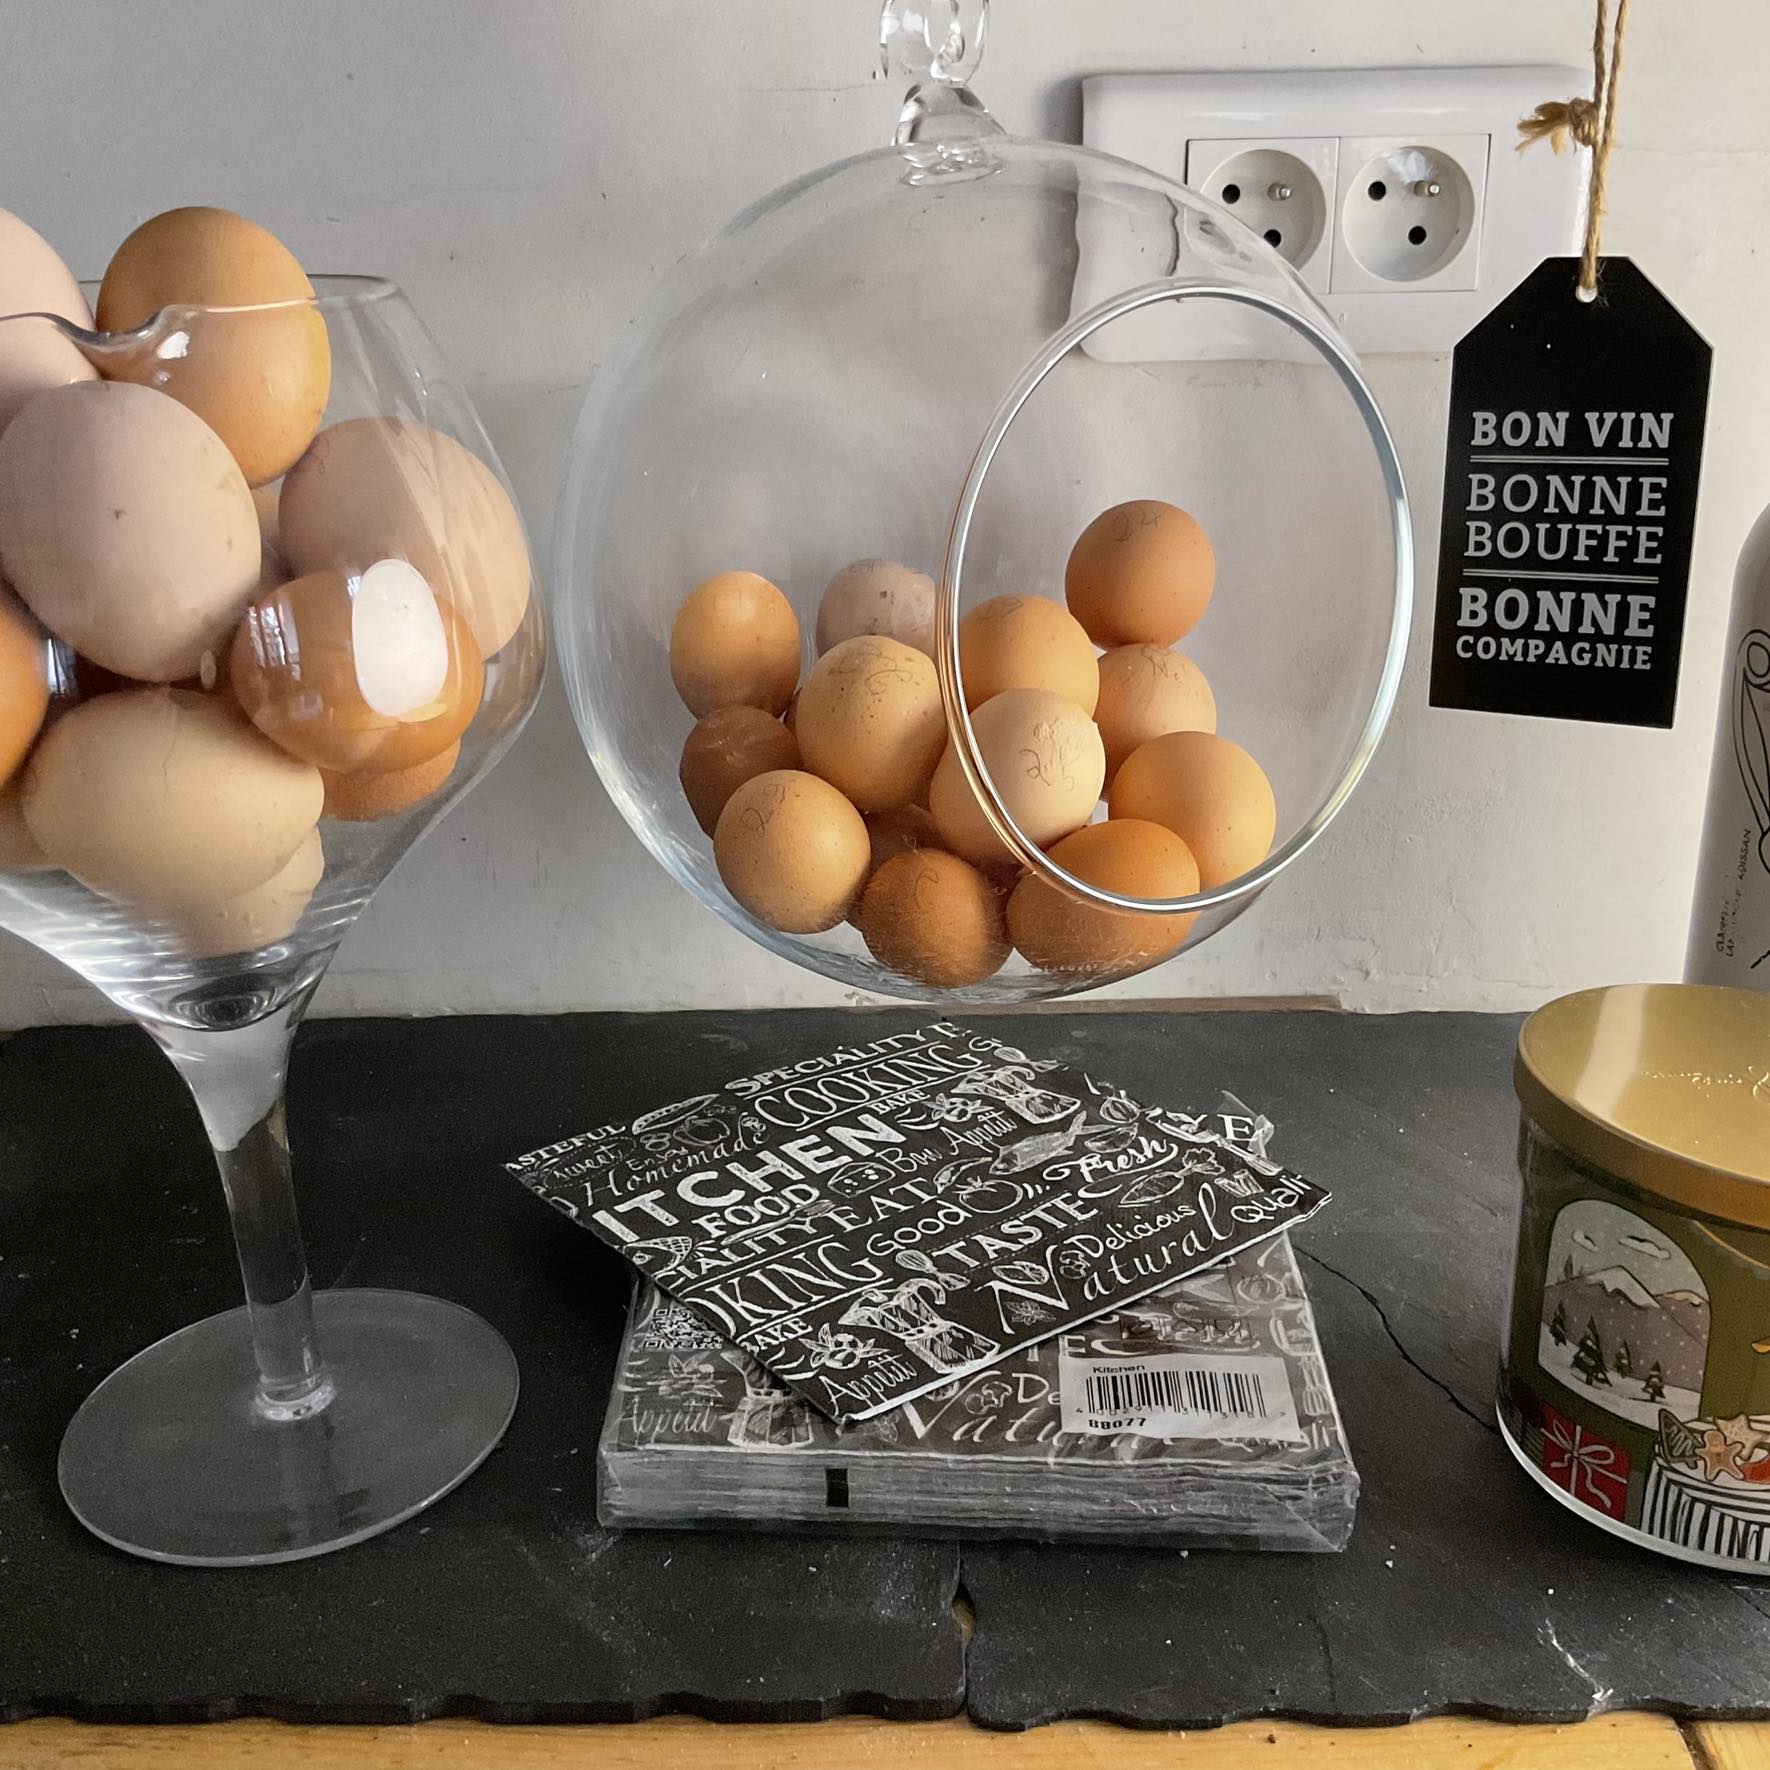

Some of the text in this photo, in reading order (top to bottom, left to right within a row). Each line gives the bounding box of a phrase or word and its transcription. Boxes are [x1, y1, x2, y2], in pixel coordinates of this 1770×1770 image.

[1471, 411, 1674, 448] BON VIN
[1465, 474, 1668, 516] BONNE
[1463, 521, 1664, 564] BOUFFE
[1456, 587, 1656, 637] BONNE
[1456, 635, 1652, 670] COMPAGNIE
[725, 1029, 927, 1096] SPECIALITY
[754, 1044, 983, 1127] COOKING
[867, 1089, 931, 1114] BAKE
[583, 1112, 770, 1207] Homemade
[875, 1147, 942, 1173] Bon
[1043, 1136, 1179, 1187] Fresh
[691, 1184, 822, 1239] FOOD
[825, 1177, 938, 1234] EAT
[866, 1199, 973, 1256] Good
[931, 1192, 1099, 1269] TASTE
[1063, 1203, 1197, 1259] Delicious
[973, 1182, 1235, 1336] Natural
[1092, 1365, 1146, 1374] Kitchen
[1088, 1417, 1147, 1430] 88077
